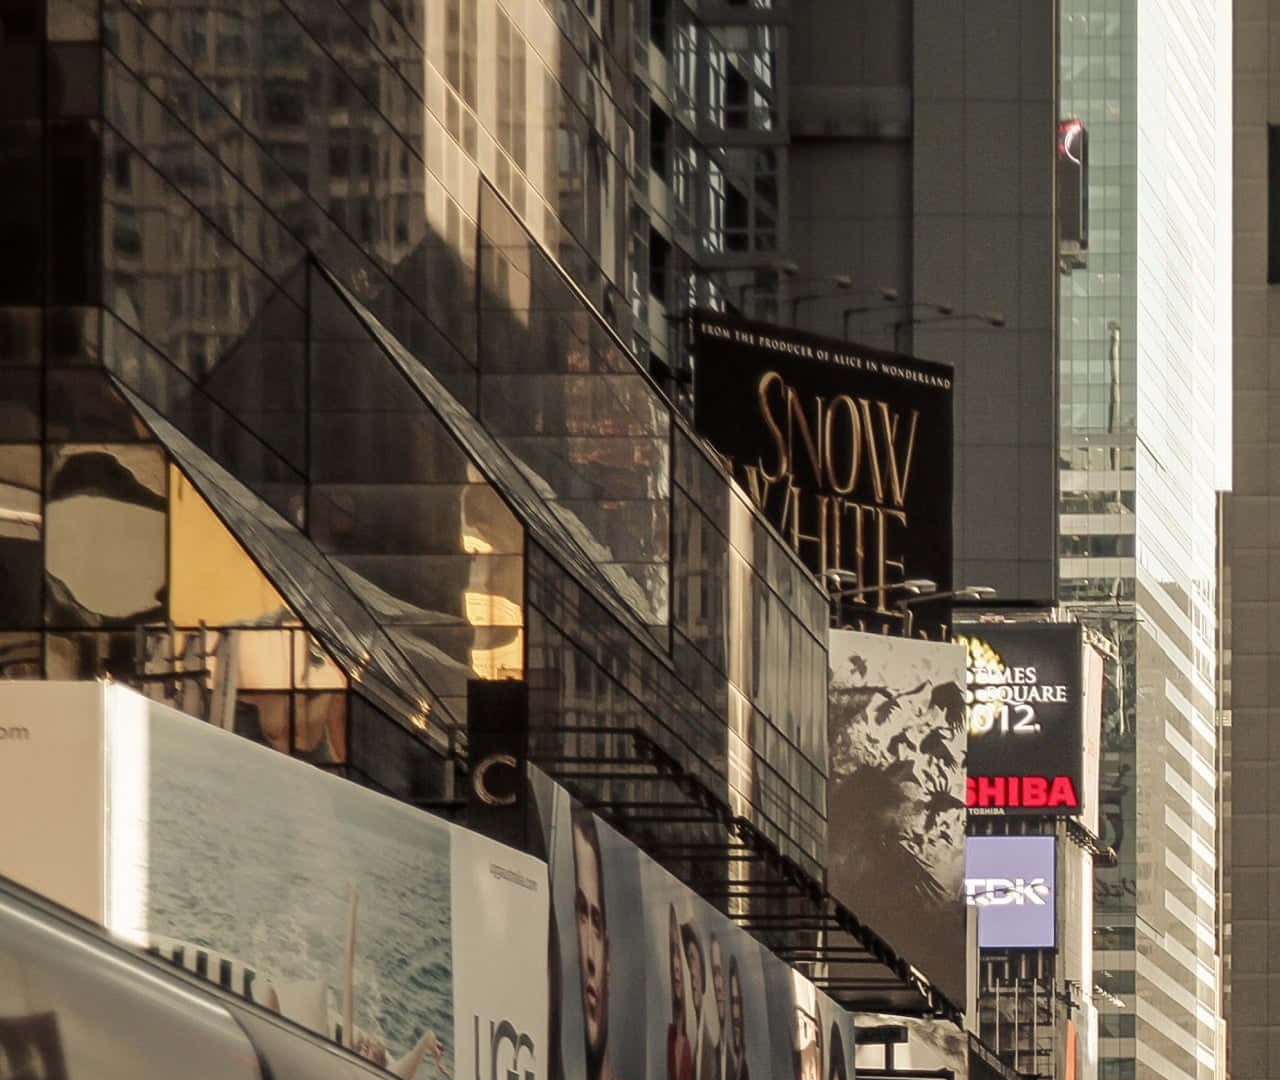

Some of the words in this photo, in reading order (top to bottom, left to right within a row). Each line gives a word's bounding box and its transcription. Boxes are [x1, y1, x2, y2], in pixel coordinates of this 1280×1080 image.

[701, 322, 730, 340] FROM
[735, 330, 755, 346] THE
[759, 336, 813, 360] PRODUCER
[817, 350, 829, 361] OF
[834, 353, 863, 370] ALICE
[866, 360, 879, 371] IN
[882, 364, 952, 390] WONDERLAND
[759, 371, 921, 508] SNOW
[985, 685, 1068, 705] SQUARE
[966, 775, 1078, 809] SHIBA
[965, 877, 1051, 906] TDK
